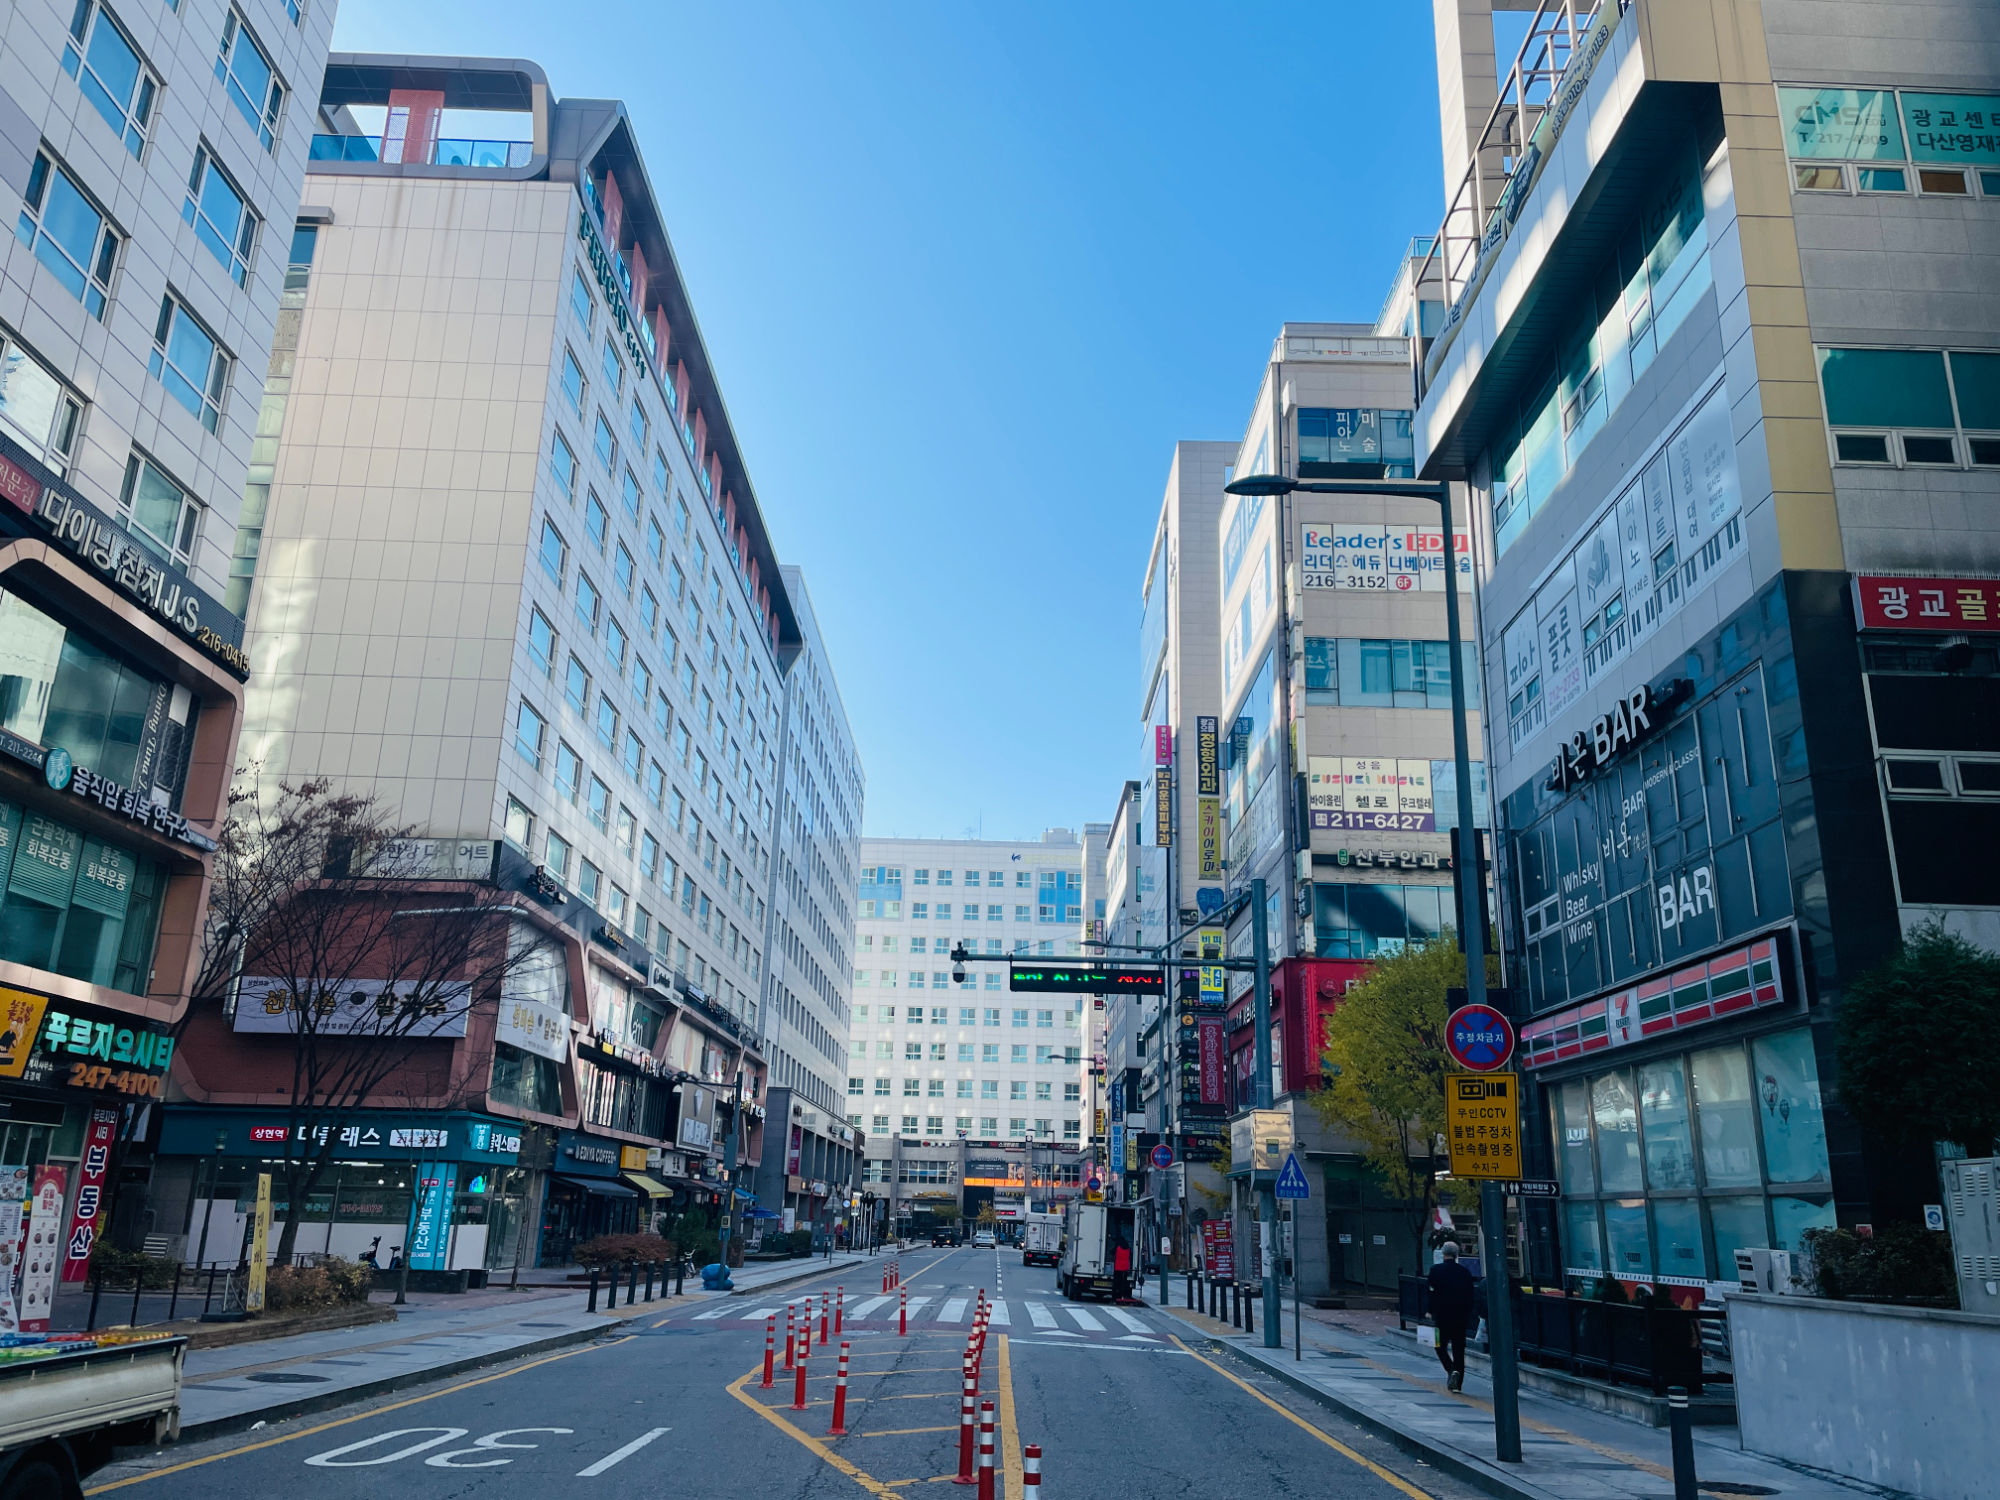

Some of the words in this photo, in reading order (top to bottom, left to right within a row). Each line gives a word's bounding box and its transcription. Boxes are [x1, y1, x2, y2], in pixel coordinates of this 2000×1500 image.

[1795, 101, 1861, 126] CMS
[1336, 411, 1352, 453] 피아노
[1361, 411, 1377, 453] 미술
[1707, 471, 1721, 493] 입시반
[1624, 494, 1641, 570] 피아노
[1305, 554, 1348, 571] 리더스
[1352, 554, 1382, 571] 에듀
[1304, 574, 1386, 589] 216-3152
[1396, 577, 1410, 588] 6F
[1878, 587, 2000, 621] 광교골
[201, 632, 250, 675] 216-0415
[1548, 667, 1581, 706] 212-2733
[1590, 684, 1652, 767] BAR
[8, 739, 43, 764] 211-2244
[1356, 761, 1381, 770] 성음
[1644, 767, 1669, 790] MODERN
[73, 767, 122, 813] 움직임
[121, 789, 152, 826] 회복
[154, 804, 192, 844] 연구소
[1310, 794, 1342, 807] 바이올린
[1356, 796, 1389, 809] 첼로
[1400, 797, 1432, 810] 우크렐레
[1622, 790, 1645, 818] BAR
[32, 817, 77, 850] 근골격계
[1331, 814, 1425, 830] 211-6427
[1202, 804, 1216, 872] 스카이아로마
[26, 840, 72, 870] 회복운동
[101, 845, 122, 868] 통증
[1355, 849, 1440, 870] 산부인과
[86, 862, 127, 891] 회복운동
[1563, 861, 1599, 894] Whisky
[1199, 890, 1223, 905] 치과
[1565, 894, 1589, 920] Beer
[1659, 866, 1715, 930] BAR
[1567, 920, 1593, 945] Wine
[1214, 969, 1222, 987] 4F
[46, 1011, 175, 1072] 푸르지오시티
[1455, 1031, 1505, 1043] 주정차금지
[68, 1062, 162, 1099] 247-4100
[93, 1109, 117, 1124] 푸르지오
[1457, 1108, 1507, 1119] 무인CCTV
[95, 1126, 108, 1140] 시티
[254, 1128, 285, 1140] 상현역
[1453, 1125, 1512, 1139] 불법주정차
[580, 1146, 596, 1162] EDIYA
[596, 1148, 615, 1165] COFFEE
[1454, 1142, 1514, 1156] 단속촬영중
[1471, 1161, 1500, 1174] 수지구
[70, 1144, 108, 1260] 부동산
[1279, 1189, 1305, 1197] 횡단보도
[414, 1207, 432, 1250] 부동산
[304, 1427, 575, 1468] 30
